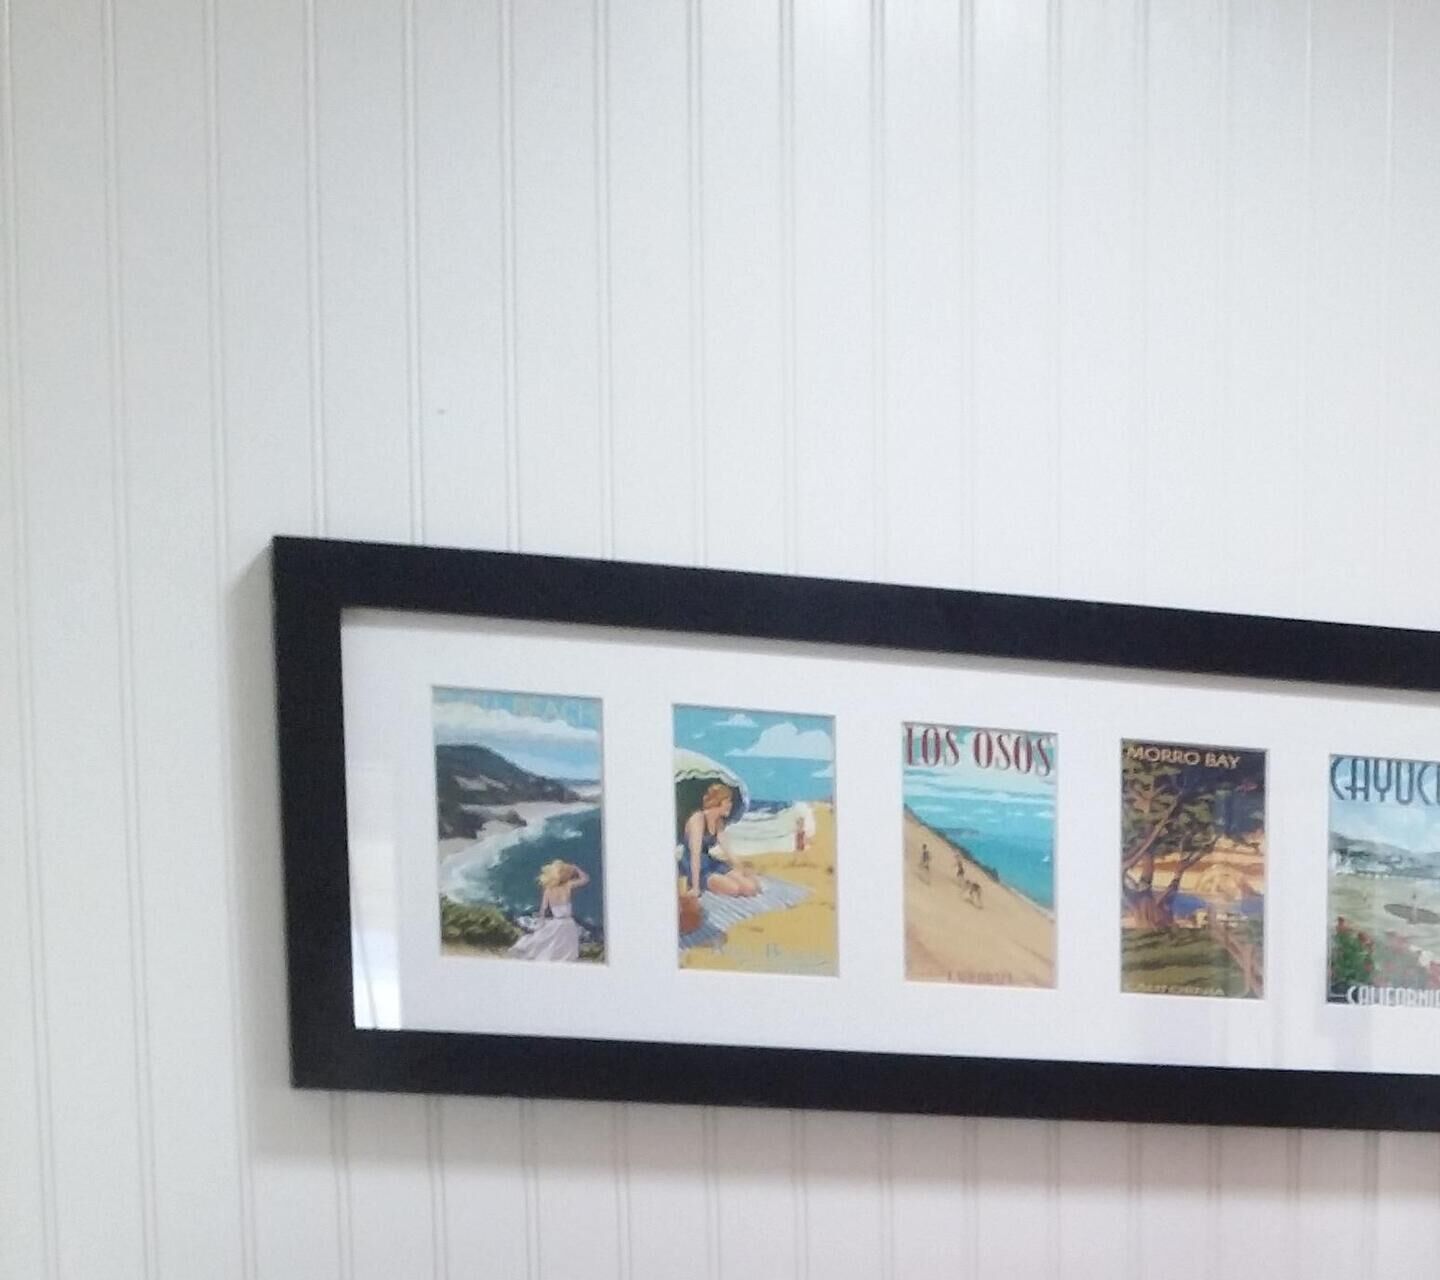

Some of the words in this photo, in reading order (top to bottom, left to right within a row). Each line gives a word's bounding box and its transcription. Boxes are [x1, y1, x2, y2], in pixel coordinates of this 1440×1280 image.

[973, 730, 1052, 777] OSOS
[1127, 746, 1200, 766] MORRO
[1205, 752, 1240, 769] BAY
